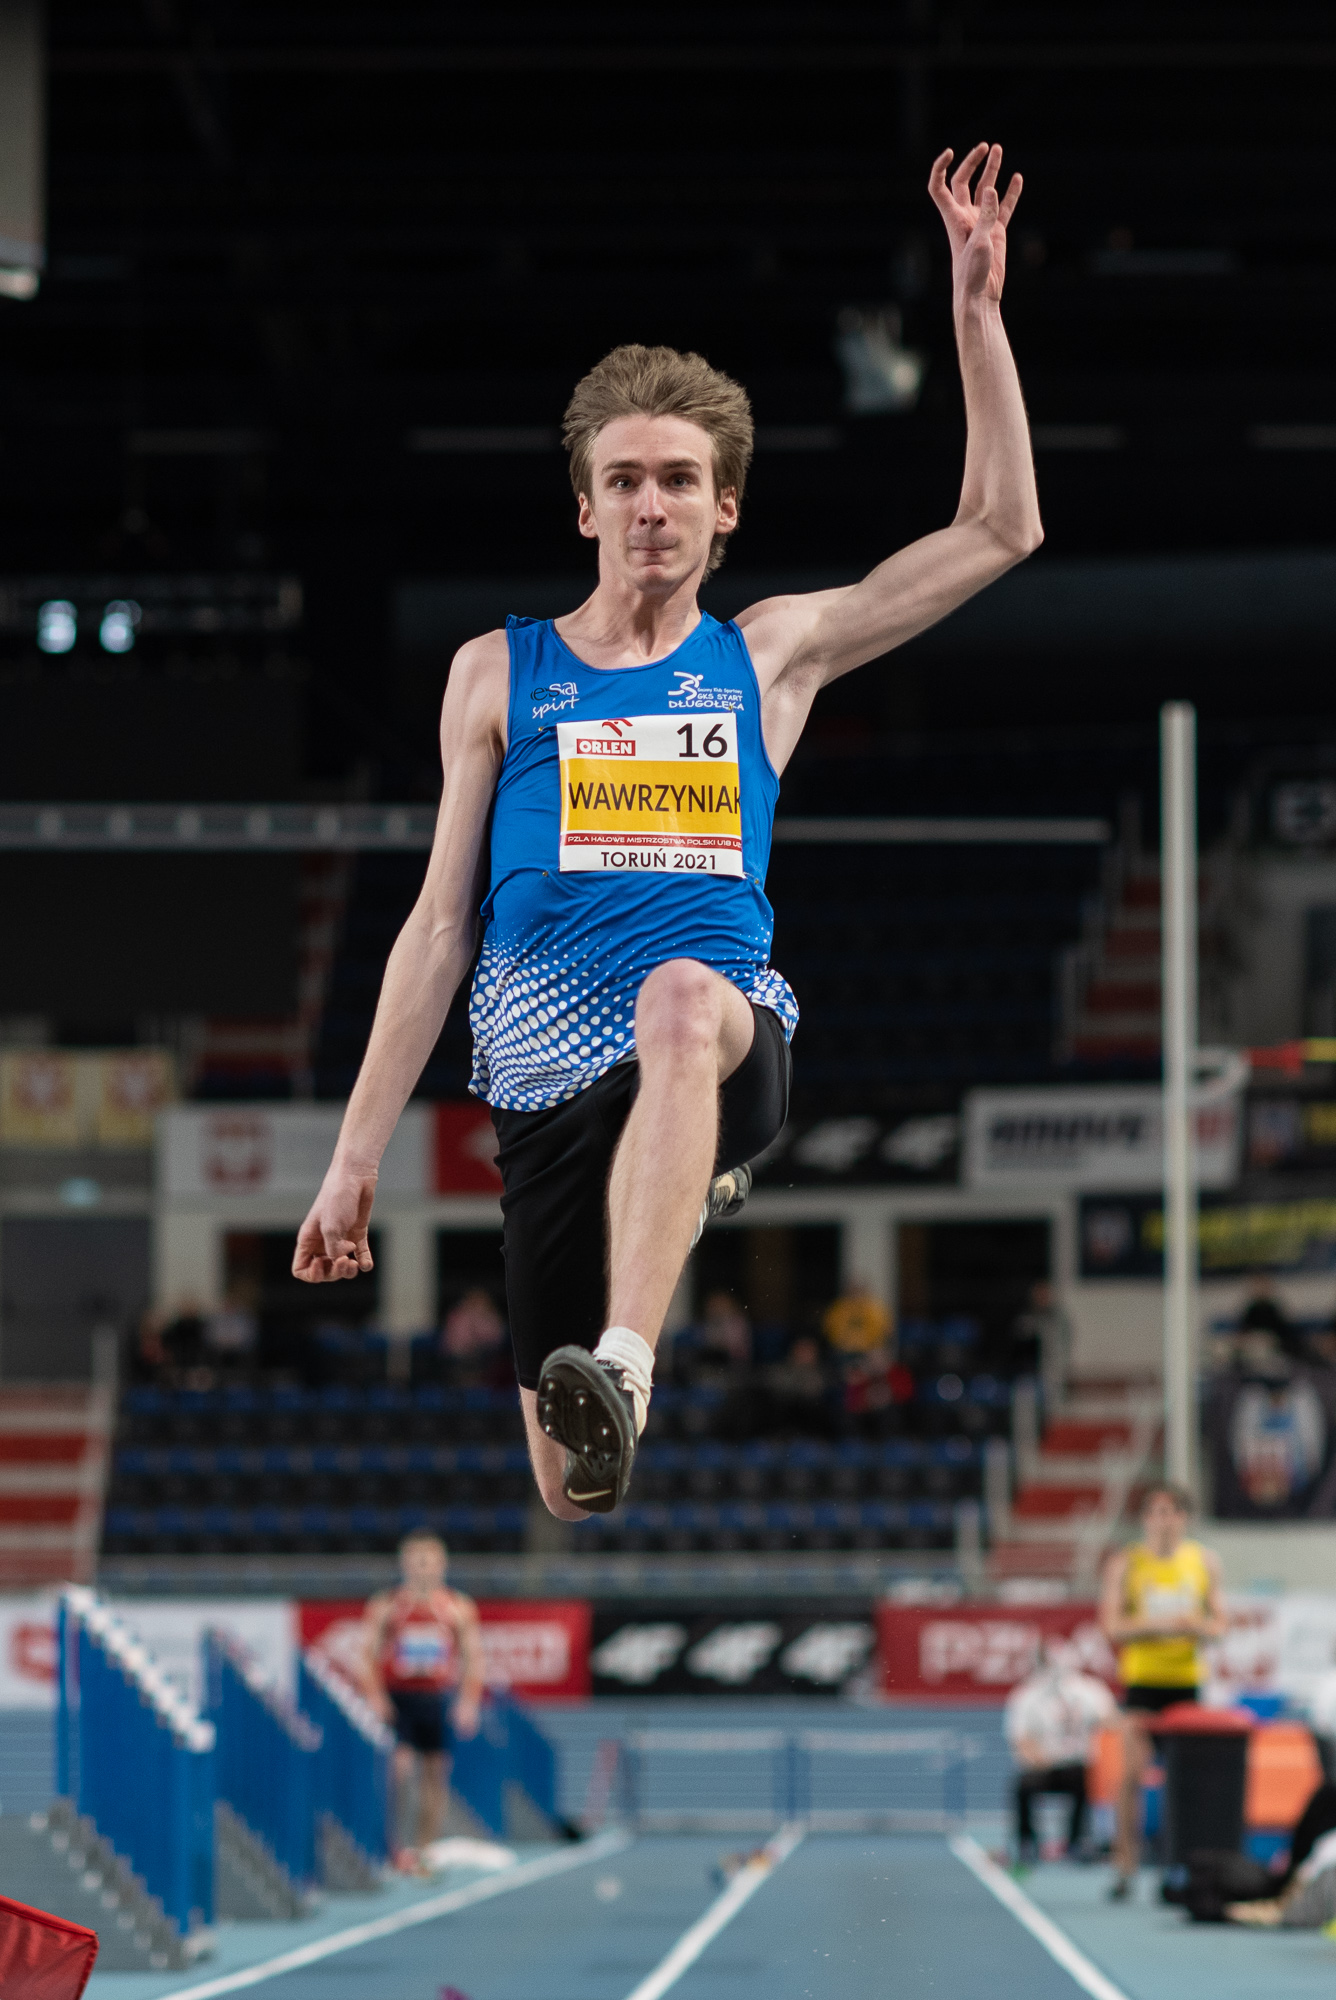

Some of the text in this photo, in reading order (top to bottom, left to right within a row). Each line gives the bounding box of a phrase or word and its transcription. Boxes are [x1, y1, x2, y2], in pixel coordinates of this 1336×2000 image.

[717, 694, 743, 702] START
[579, 740, 632, 755] ORLEN
[676, 723, 728, 758] 16
[626, 837, 686, 845] MISTRZOSTWA
[686, 837, 715, 846] POLSKI
[601, 848, 716, 870] TORUŃ 2021
